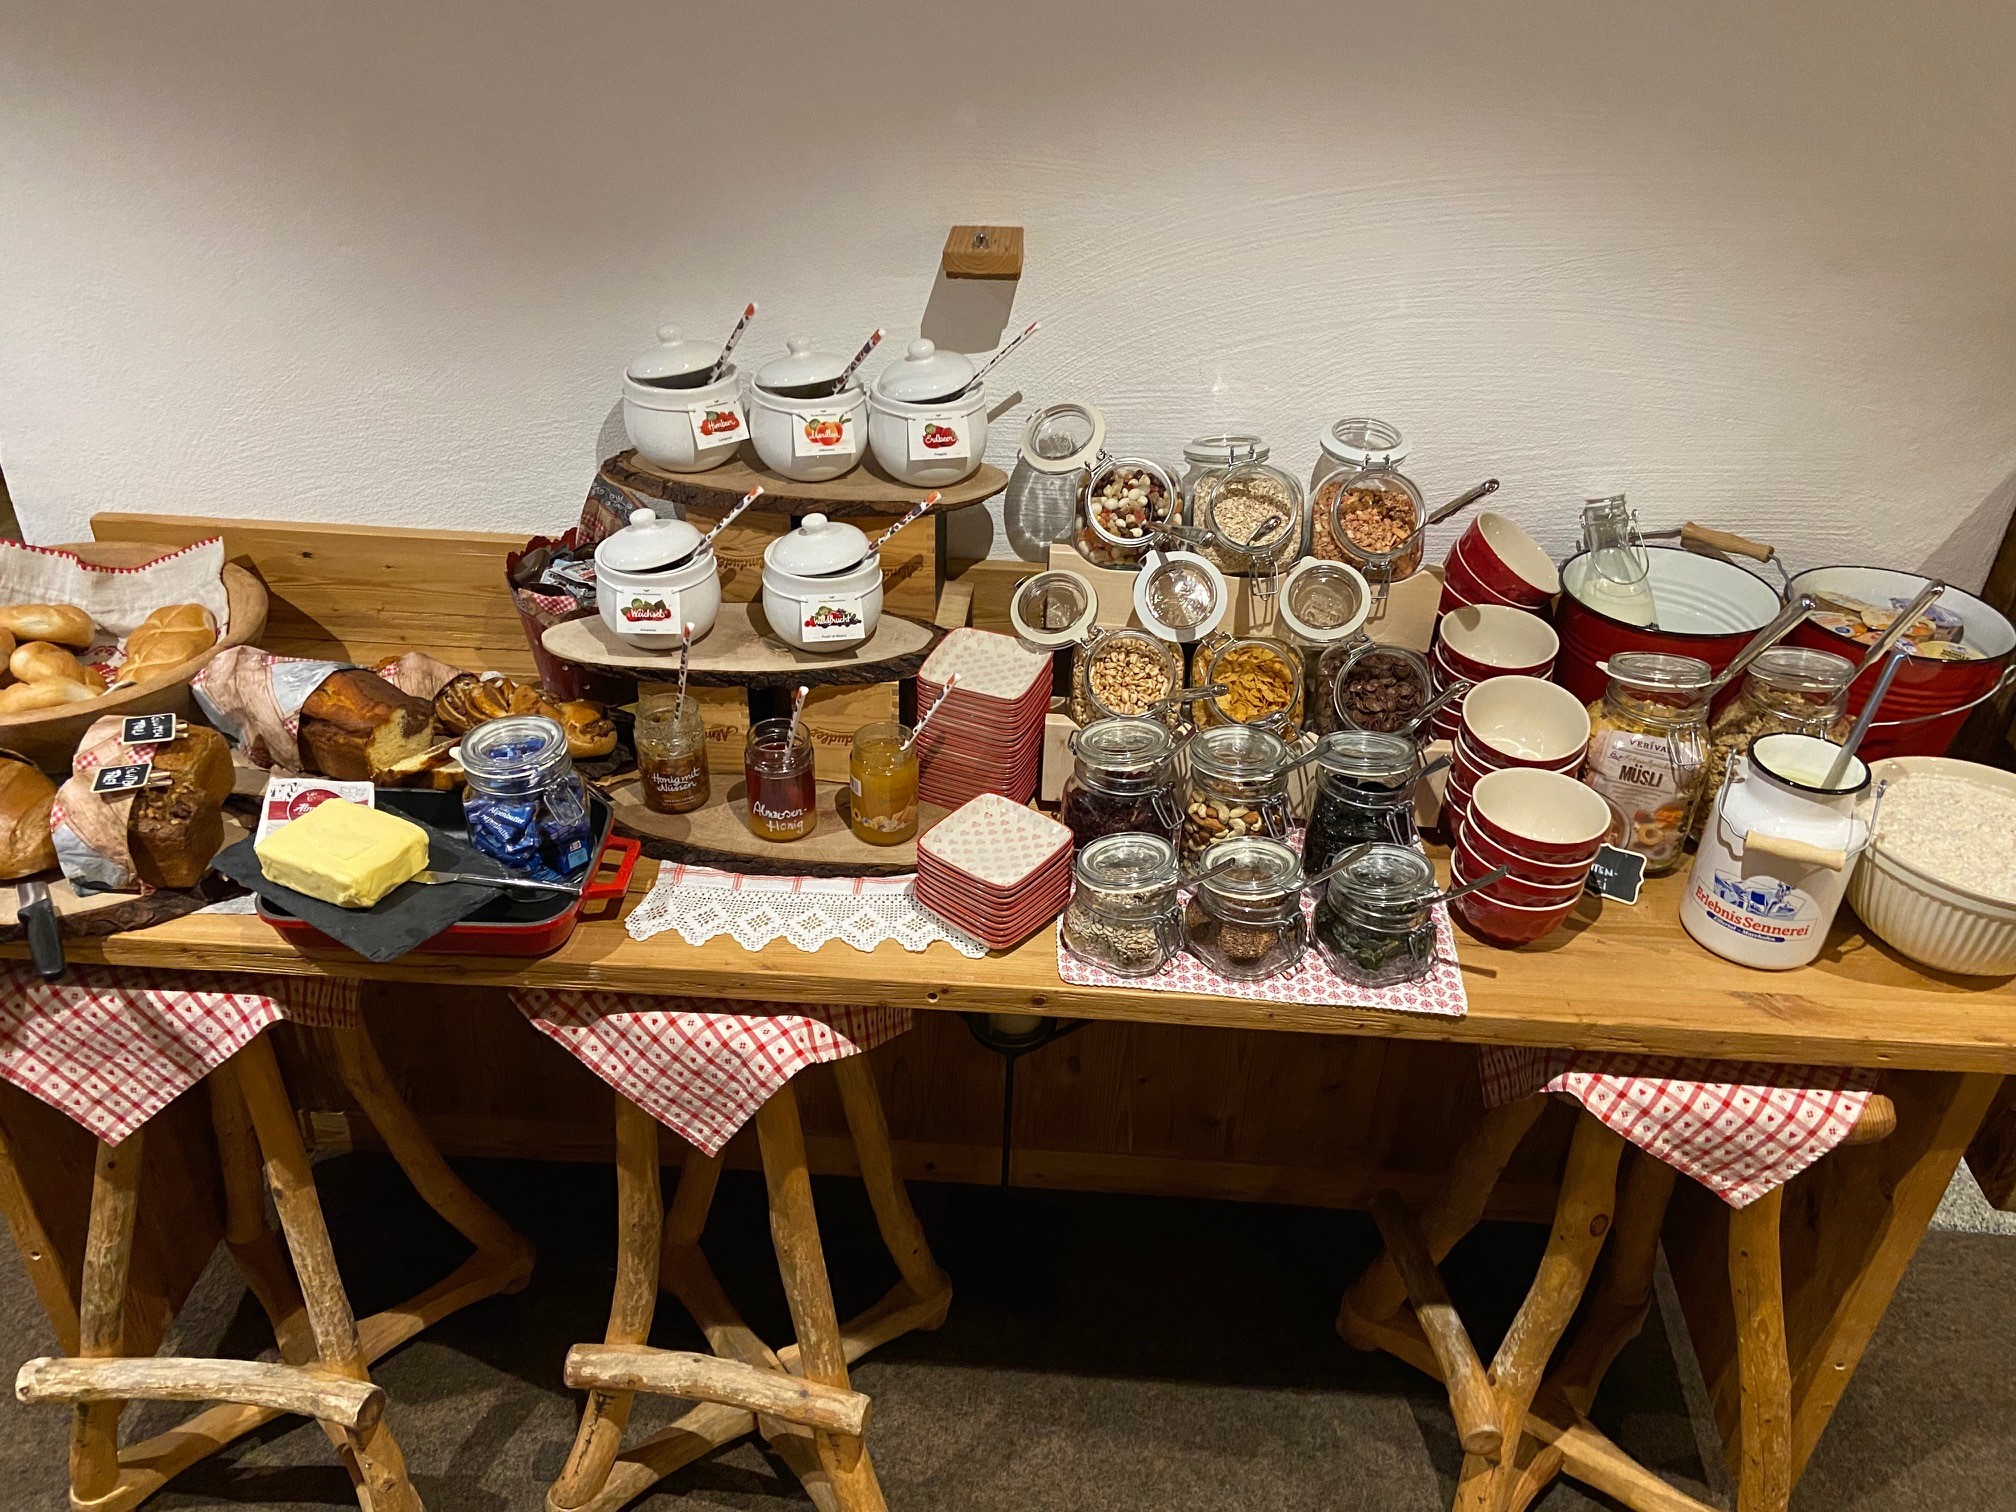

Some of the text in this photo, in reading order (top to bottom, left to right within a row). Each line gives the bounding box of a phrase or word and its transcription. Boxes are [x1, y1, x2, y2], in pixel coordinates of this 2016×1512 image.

[925, 433, 956, 444] Erdbeer
[651, 767, 700, 786] Honig mit
[1619, 764, 1663, 787] MÜSLI
[488, 806, 525, 824] Alpenbutter
[766, 820, 803, 834] Honig
[1695, 885, 1810, 936] Erlebnis Sennerei
